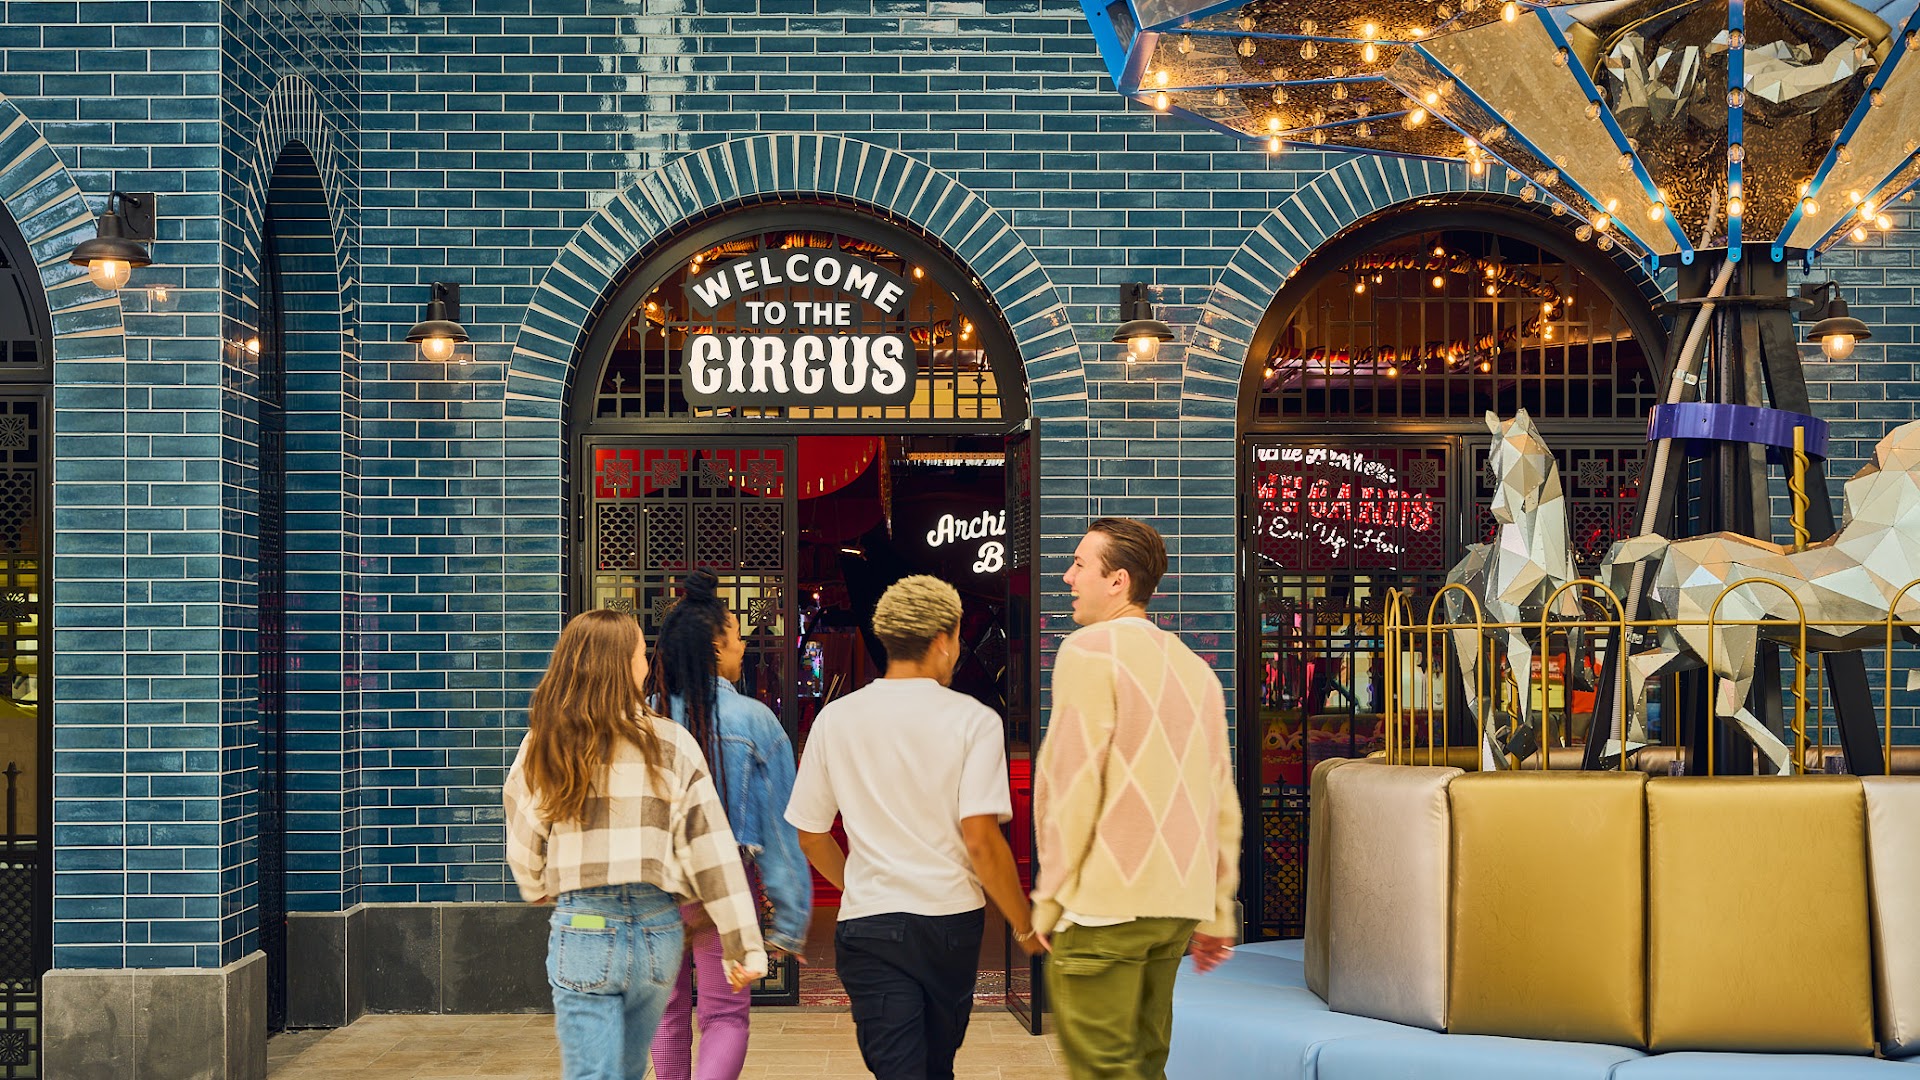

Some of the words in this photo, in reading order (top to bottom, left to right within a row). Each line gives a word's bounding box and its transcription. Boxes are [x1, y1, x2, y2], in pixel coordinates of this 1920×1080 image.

[692, 253, 904, 314] WELCOME
[745, 301, 787, 325] TO
[793, 302, 850, 326] THE
[688, 335, 906, 395] CIRCUS
